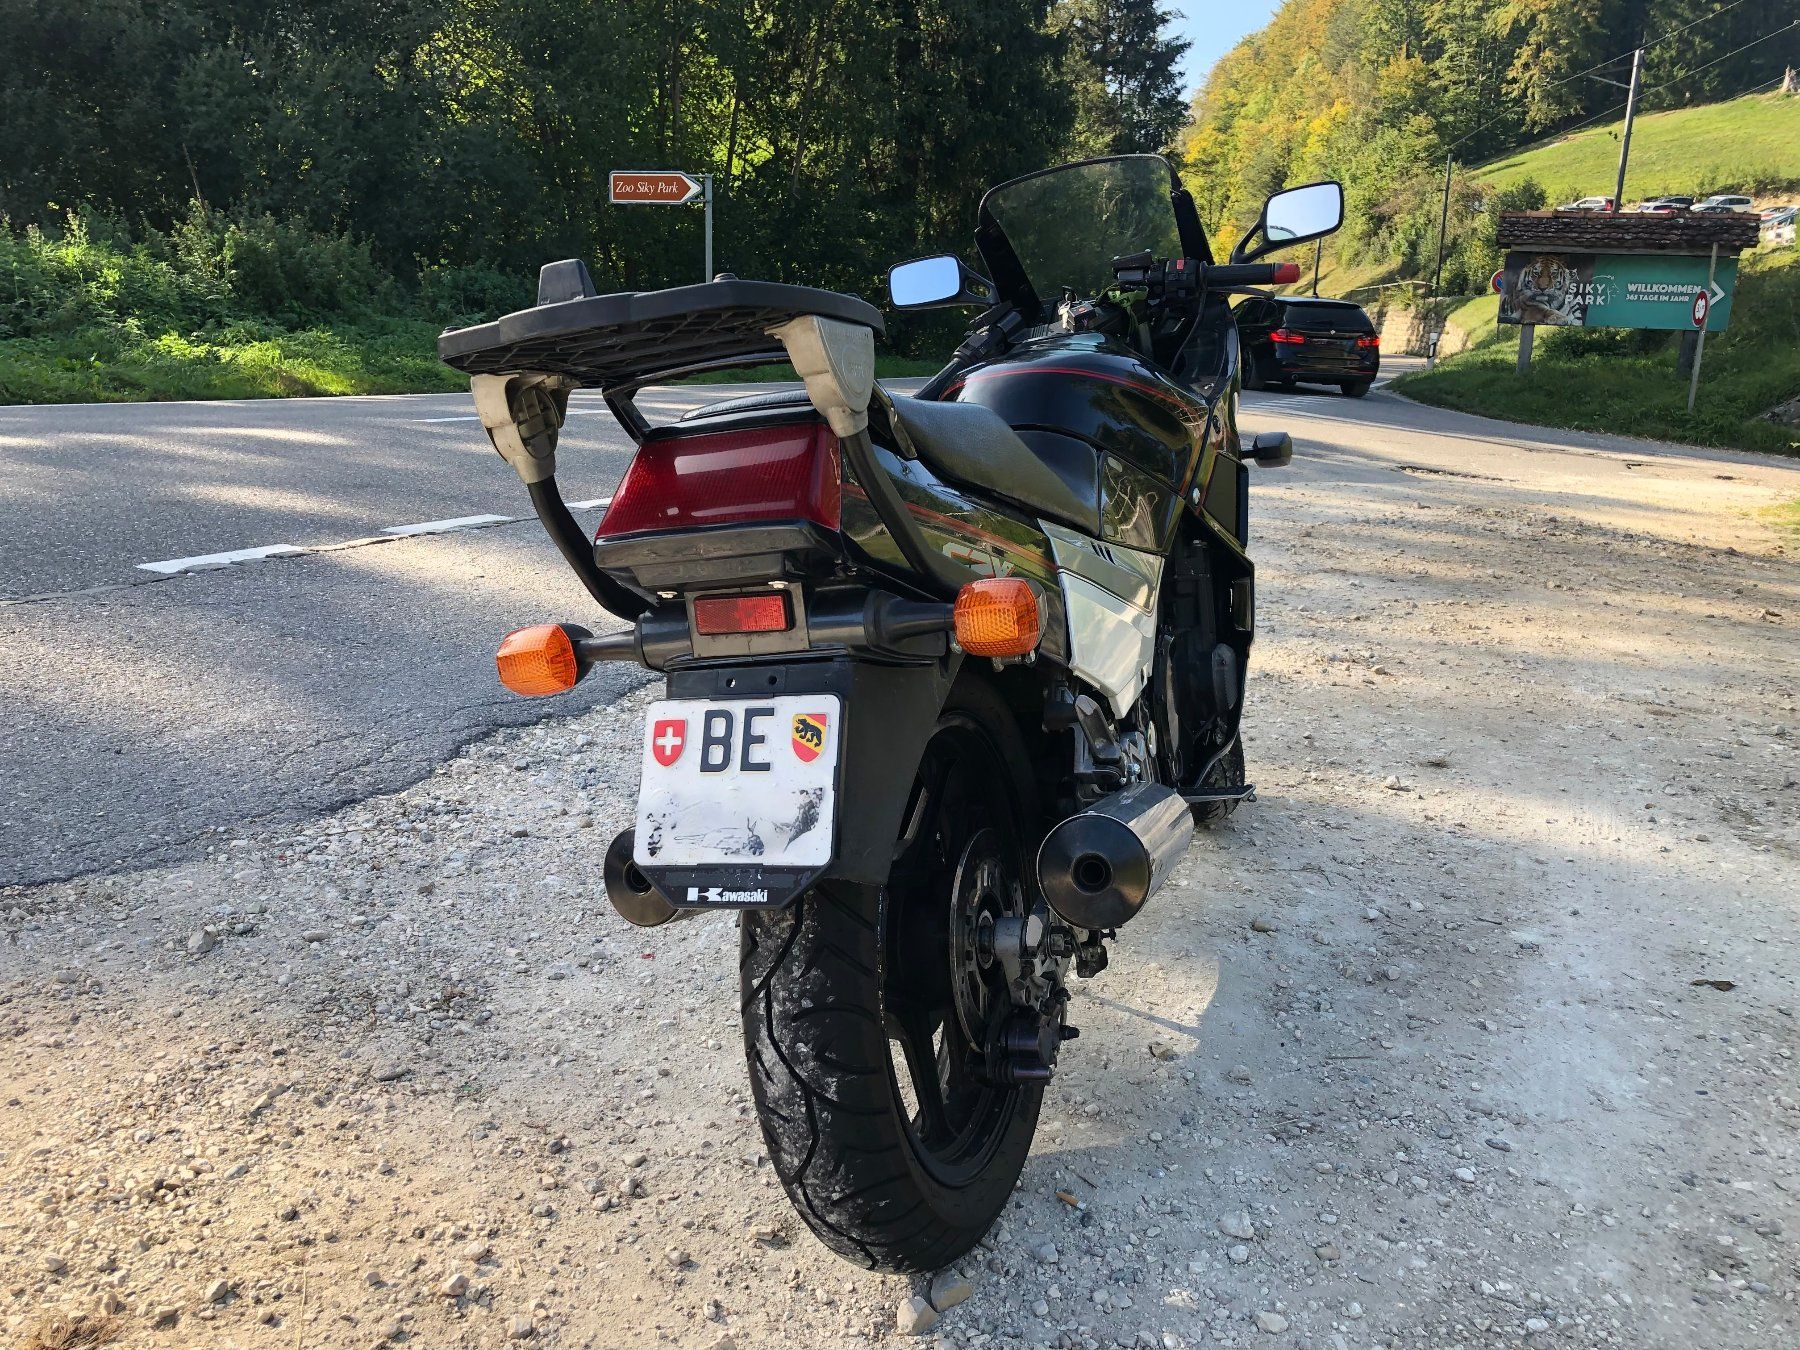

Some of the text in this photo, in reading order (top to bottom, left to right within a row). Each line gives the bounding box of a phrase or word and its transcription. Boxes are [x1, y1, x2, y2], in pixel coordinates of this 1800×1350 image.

[616, 181, 634, 193] Zoo
[657, 181, 679, 193] Park
[1568, 282, 1606, 294] SIKY
[1627, 283, 1702, 294] WILLKOMMEN
[1564, 294, 1606, 306] PARK
[699, 707, 775, 773] BE
[686, 887, 768, 903] Kawasaki
